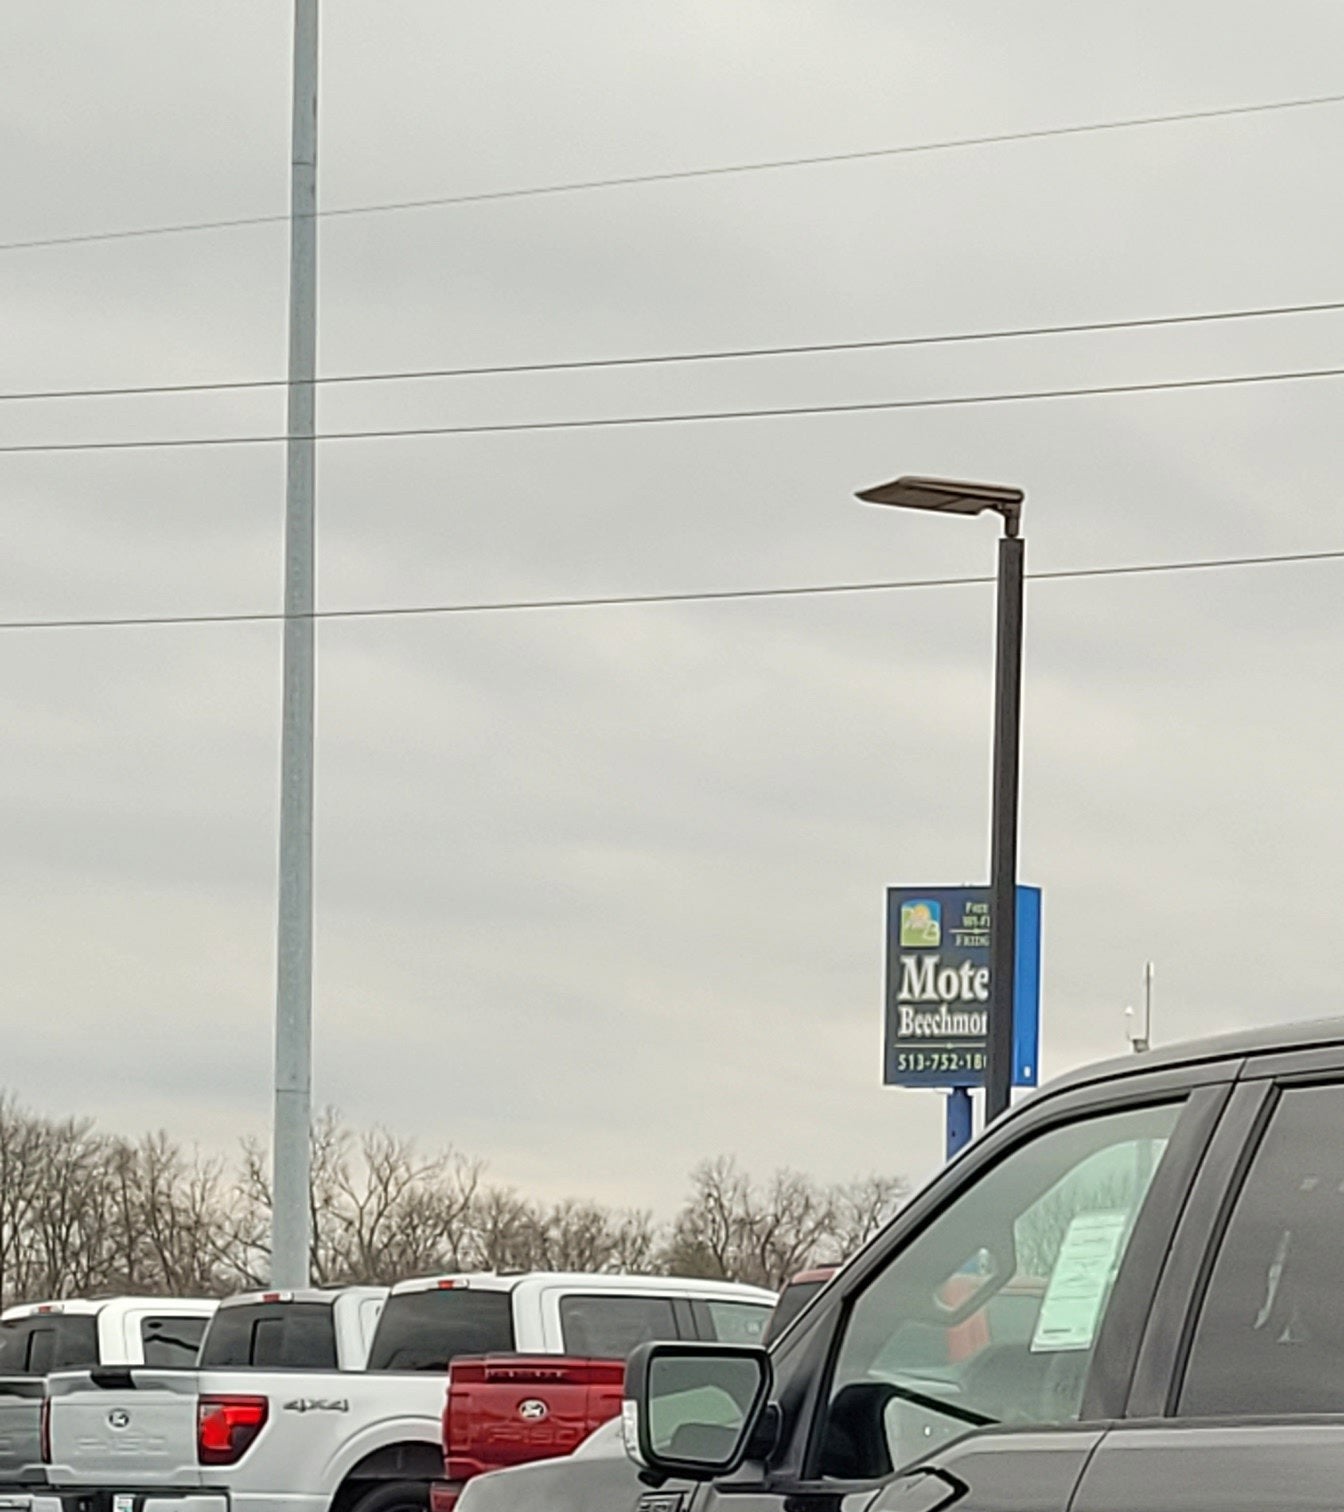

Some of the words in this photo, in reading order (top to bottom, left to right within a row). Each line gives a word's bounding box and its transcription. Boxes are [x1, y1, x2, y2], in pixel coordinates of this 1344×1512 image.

[955, 934, 990, 947] FRIDG
[897, 954, 990, 1001] Mote
[897, 1003, 988, 1038] Beechmo
[897, 1053, 987, 1071] 513-752-18
